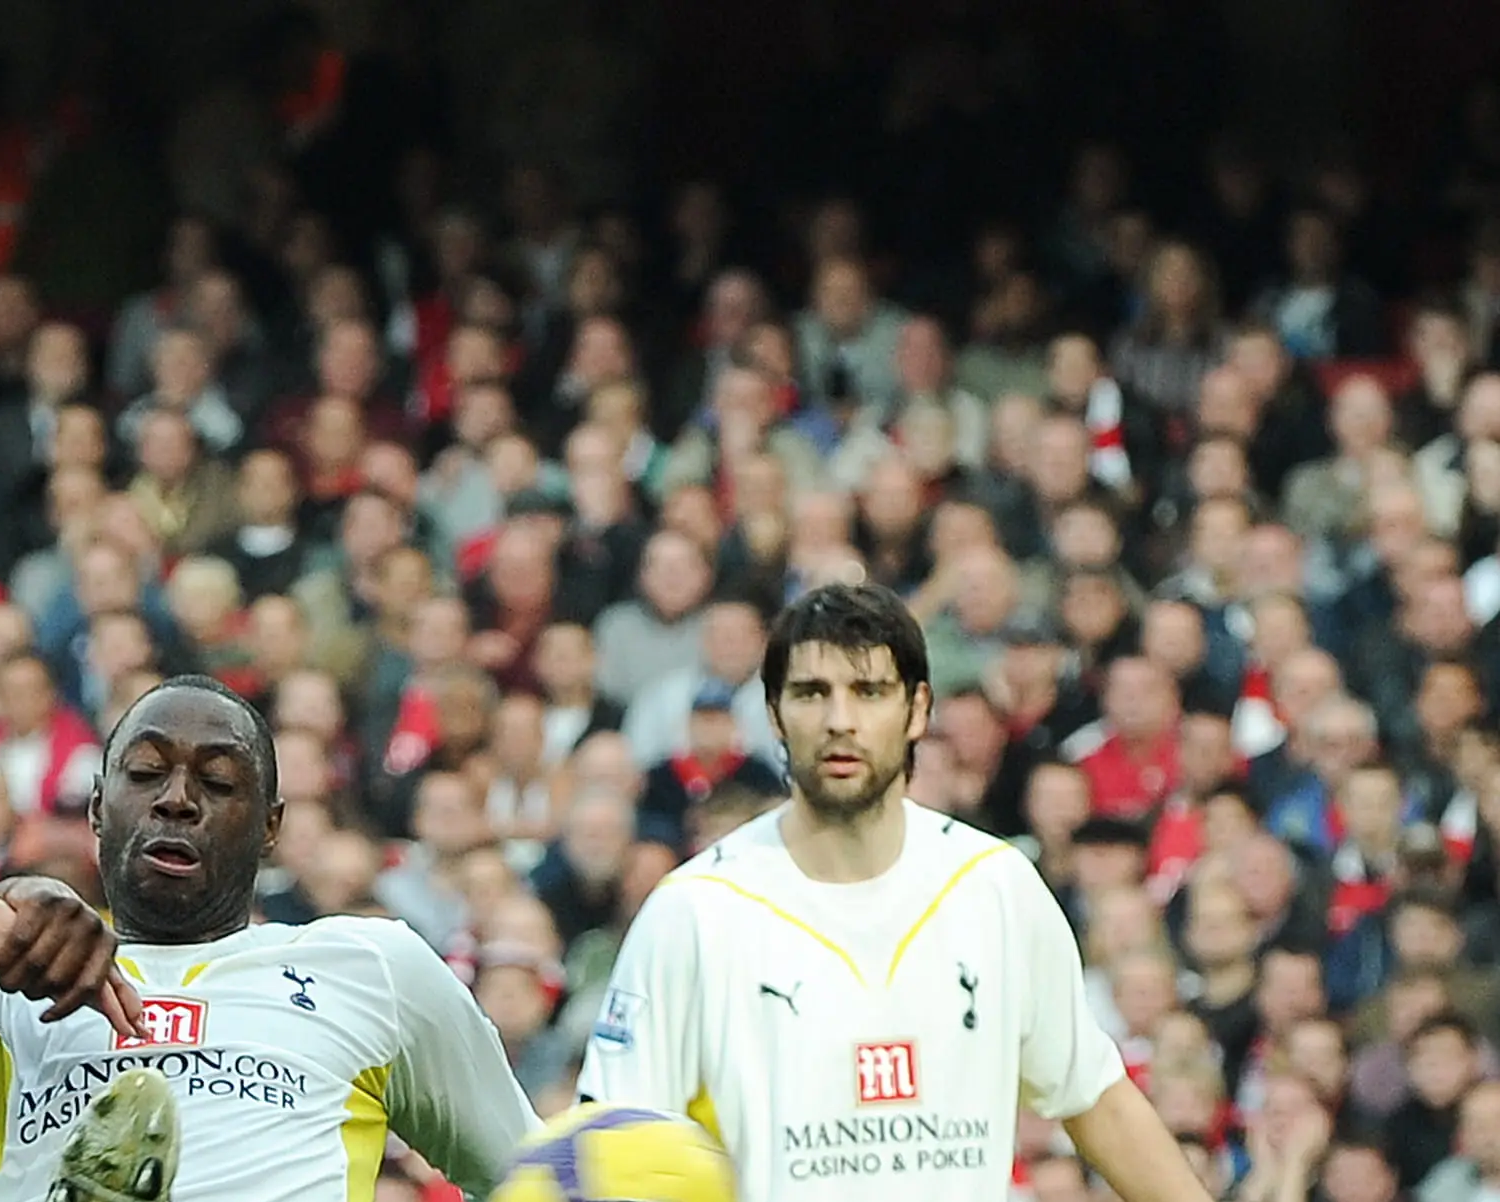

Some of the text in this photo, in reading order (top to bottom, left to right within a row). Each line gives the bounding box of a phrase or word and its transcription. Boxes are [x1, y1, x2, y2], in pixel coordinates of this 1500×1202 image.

[19, 1079, 296, 1145] CASI POKER
[789, 1152, 882, 1182] CASINO
